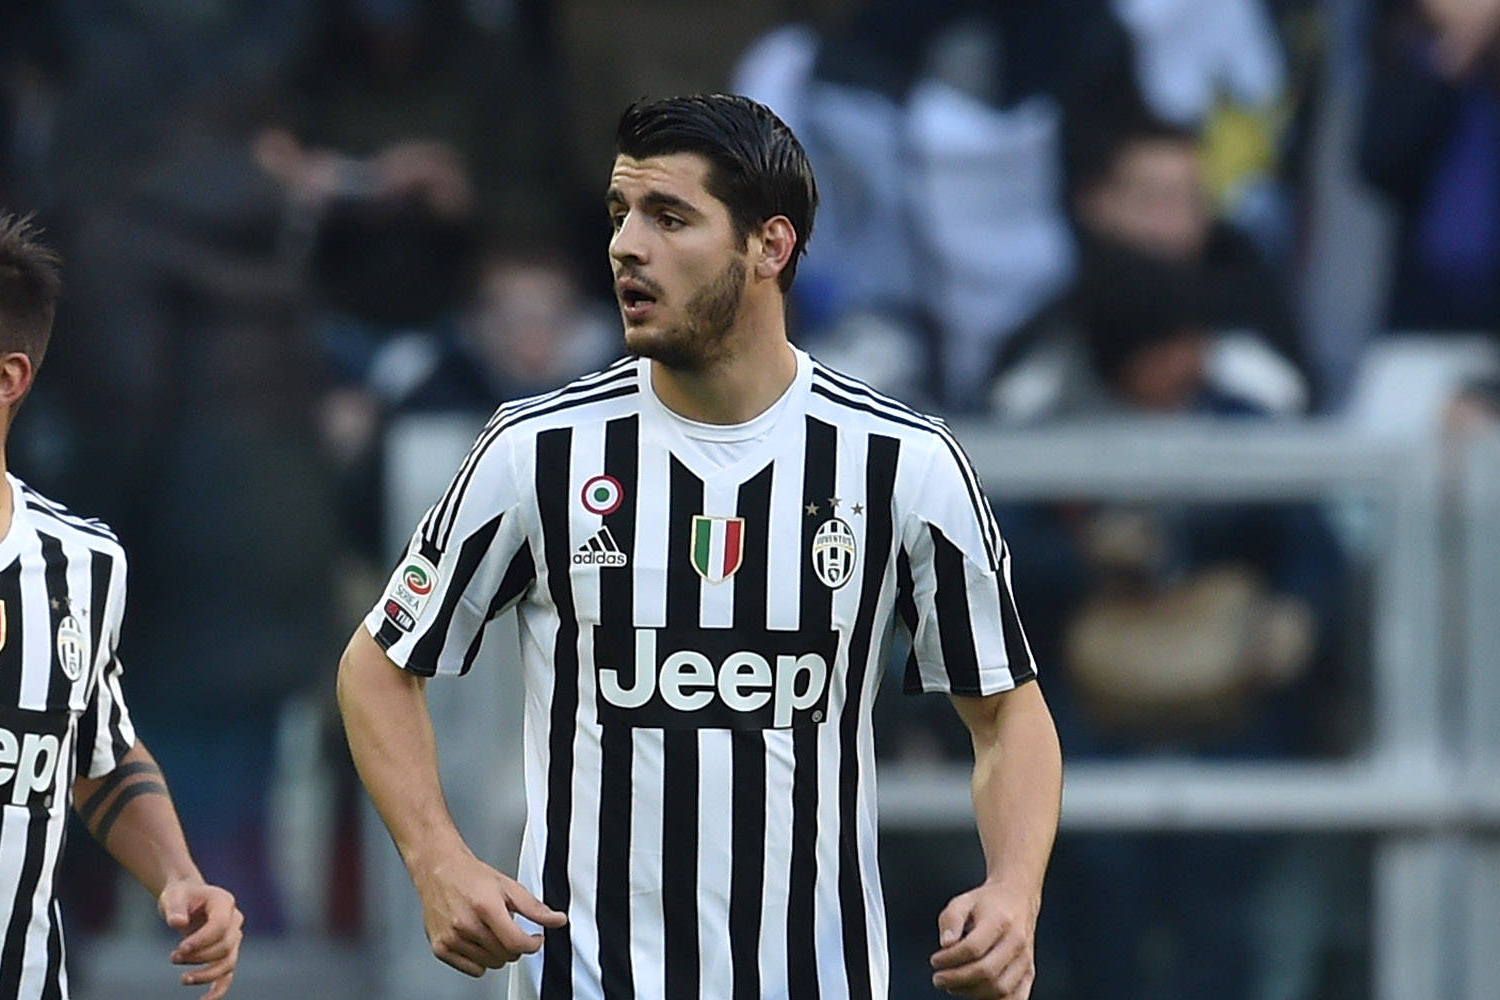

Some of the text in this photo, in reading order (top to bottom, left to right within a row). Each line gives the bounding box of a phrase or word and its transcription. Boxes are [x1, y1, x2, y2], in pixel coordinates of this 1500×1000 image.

[573, 551, 625, 565] adidas
[396, 610, 413, 630] TIM
[599, 628, 827, 728] Jeep
